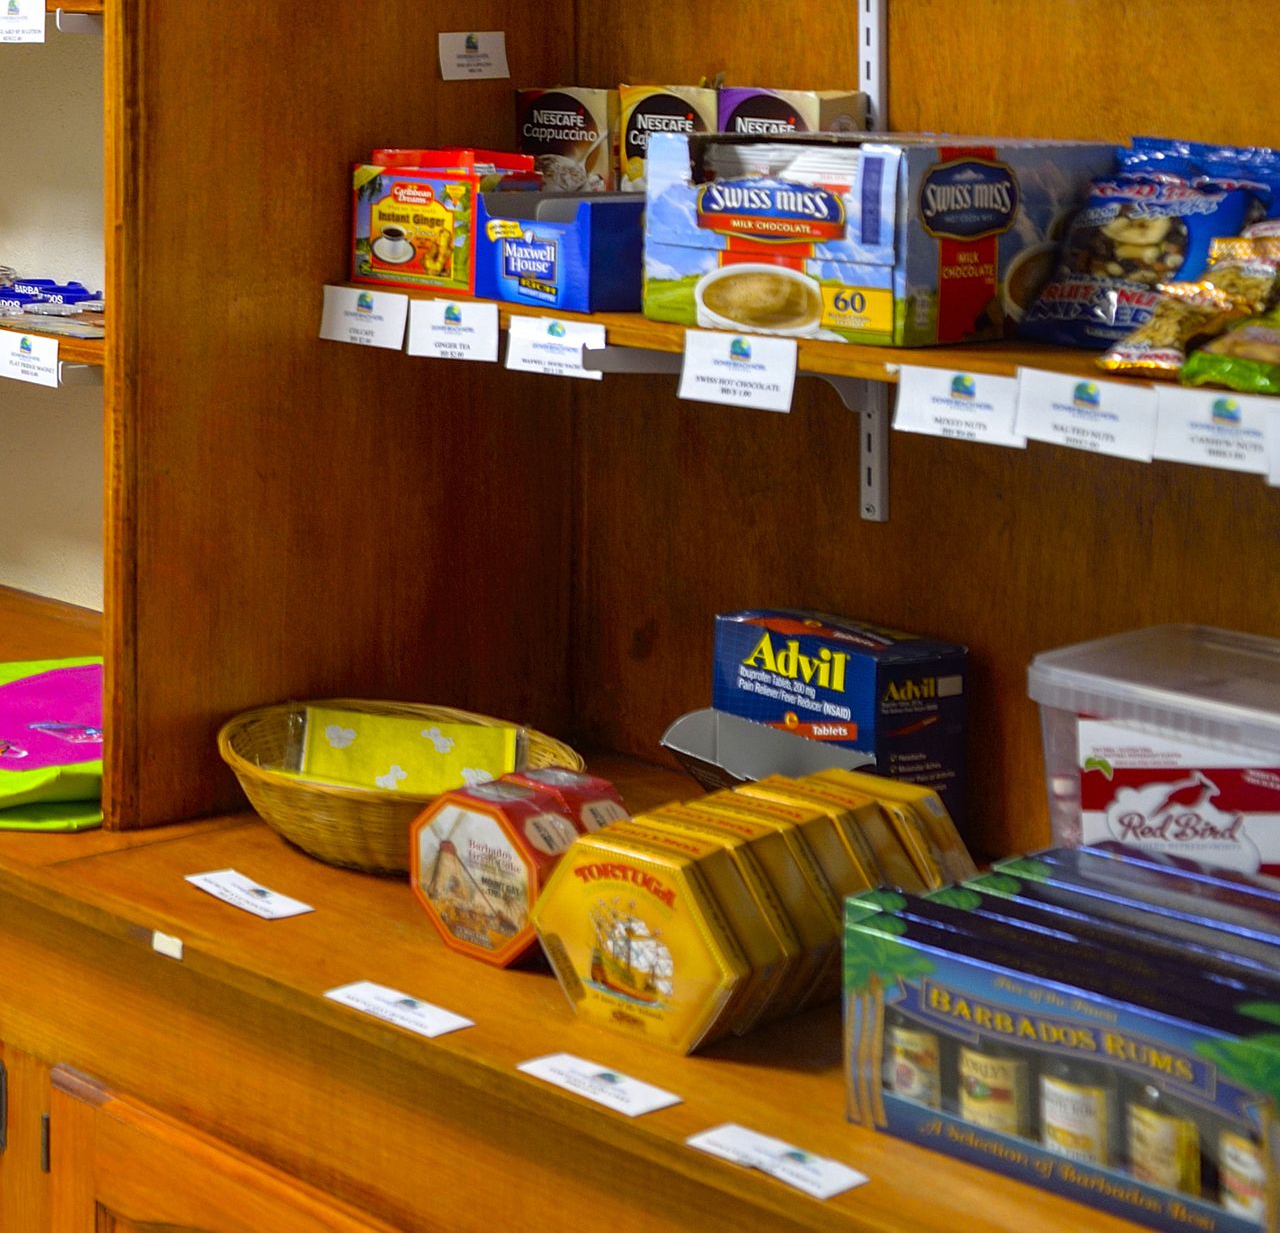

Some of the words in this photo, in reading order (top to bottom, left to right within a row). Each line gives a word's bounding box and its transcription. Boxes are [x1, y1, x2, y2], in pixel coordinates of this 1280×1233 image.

[523, 123, 597, 143] Cappuccino
[394, 186, 432, 198] Caribbean
[398, 195, 427, 204] Dreams
[378, 210, 410, 223] Instant
[412, 213, 445, 228] Ginger
[732, 219, 754, 230] MILK
[756, 221, 812, 235] CHOCOLATE
[505, 242, 555, 262] Maxwell
[956, 251, 980, 265] MILK
[509, 257, 549, 273] House
[942, 265, 995, 280] CHOCOLATE
[1042, 283, 1093, 302] RUIT
[833, 290, 867, 315] 60
[434, 341, 457, 351] GINGER
[457, 343, 471, 351] TEA
[695, 375, 718, 384] SWISS
[719, 377, 733, 386] HOT
[734, 379, 781, 393] CHOCOLATE
[933, 416, 961, 429] MIXED
[963, 419, 987, 432] NUTS
[1052, 422, 1087, 438] SALTED
[1089, 428, 1115, 443] NUTS
[1189, 436, 1232, 451] CASHEW
[1235, 439, 1264, 454] NUTS
[742, 631, 847, 693] Advil
[739, 665, 772, 684] Ibuprofen
[793, 680, 805, 695] 200
[805, 685, 816, 699] mg
[884, 677, 936, 702] Advil
[738, 676, 754, 692] Pain
[797, 695, 823, 712] Reducer
[823, 700, 851, 721] (NSAID)
[812, 724, 848, 737] Tablets
[1118, 812, 1174, 841] Red
[1174, 813, 1244, 842] Bird
[468, 838, 513, 862] Barbados
[929, 986, 1099, 1054] BARBADOS
[1101, 1028, 1197, 1083] RUMS
[919, 1117, 944, 1138] A
[947, 1121, 1032, 1168] Selection
[1034, 1152, 1055, 1179] of
[1058, 1158, 1164, 1216] Barbados
